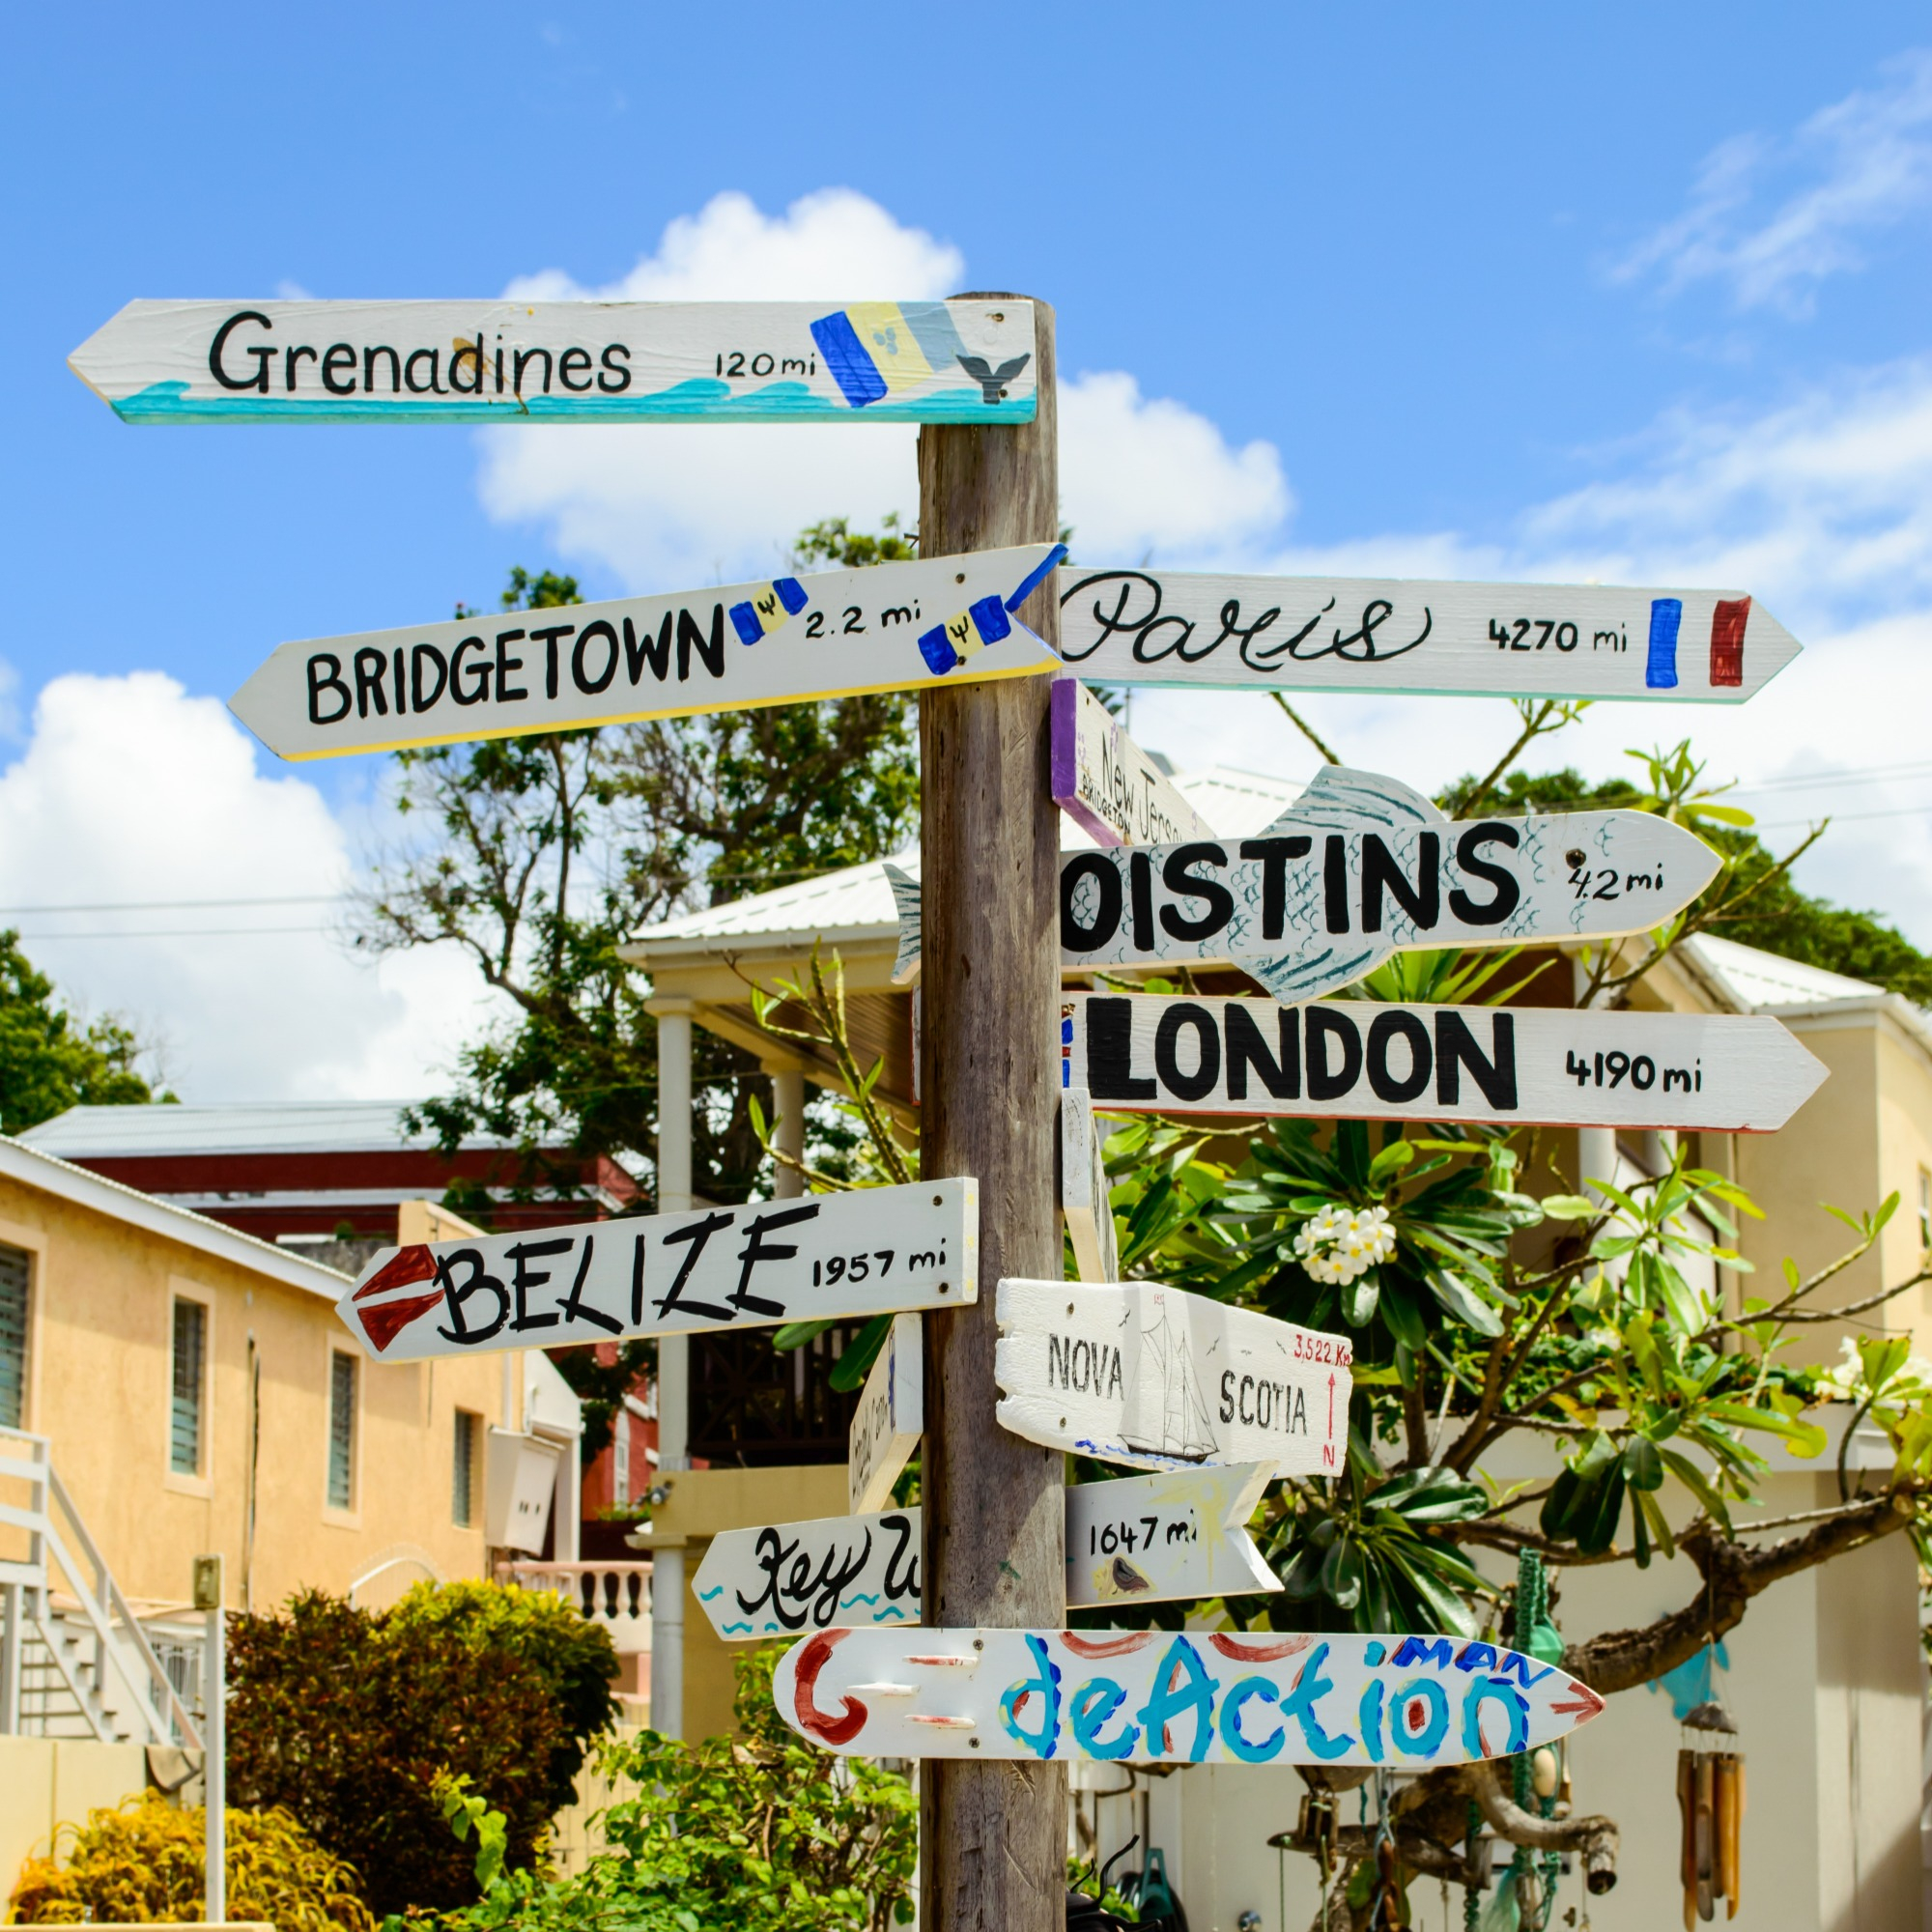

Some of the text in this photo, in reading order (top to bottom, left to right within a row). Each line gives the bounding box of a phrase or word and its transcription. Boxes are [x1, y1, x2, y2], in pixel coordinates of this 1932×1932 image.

[208, 310, 633, 396] Grenadines
[306, 603, 725, 725] BRIDGETOWN
[880, 598, 922, 628] mi
[1061, 571, 1628, 673] Paris 4270 mi
[1081, 773, 1131, 836] BRIDGETON
[1101, 729, 1135, 819] New
[1086, 997, 1519, 1111] LONDON
[435, 1203, 948, 1345] BELIZE 1957 mi
[1048, 1333, 1308, 1436] NOVA SCOTIA
[1090, 1515, 1160, 1557] 1647
